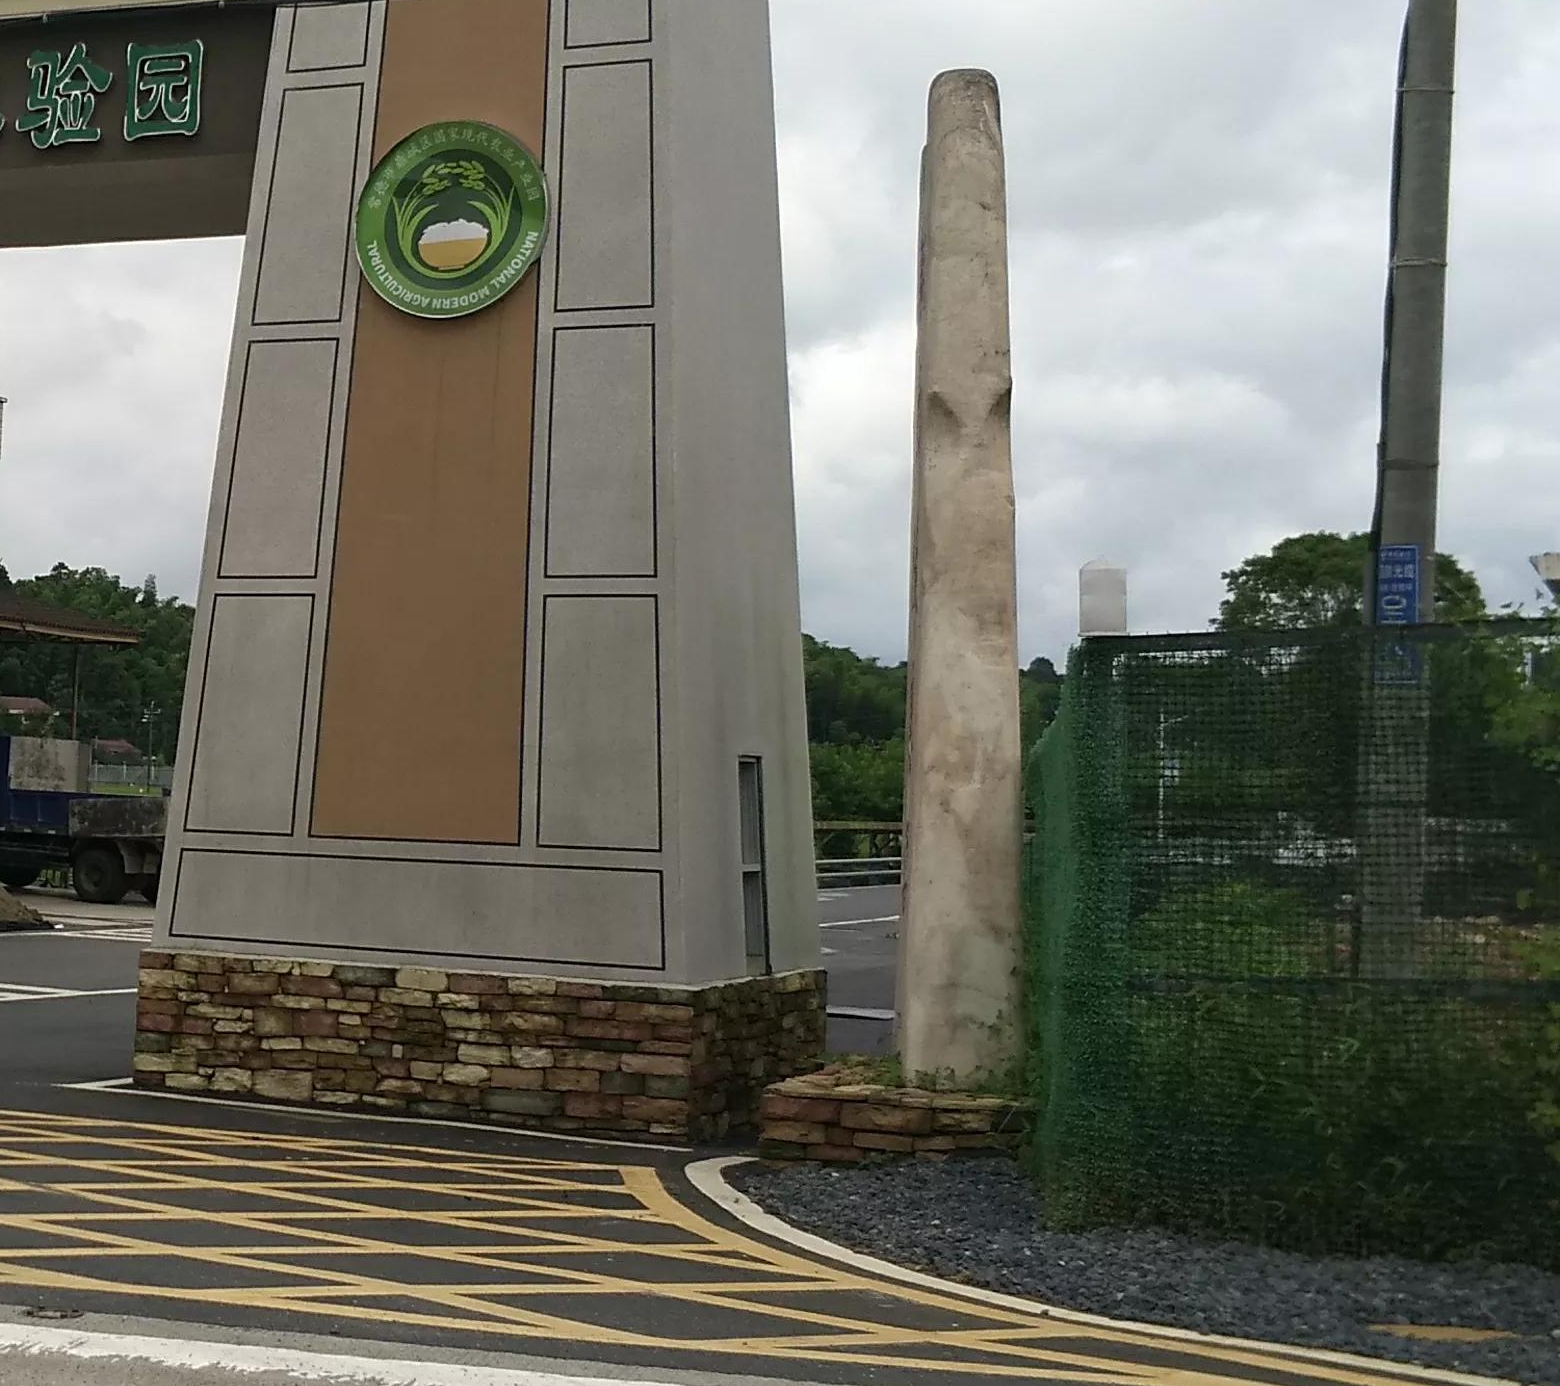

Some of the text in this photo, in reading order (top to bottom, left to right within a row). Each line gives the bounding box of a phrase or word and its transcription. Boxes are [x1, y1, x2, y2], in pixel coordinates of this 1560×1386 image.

[366, 230, 538, 310] NATIONAL MODERN AGRICULTURAL
